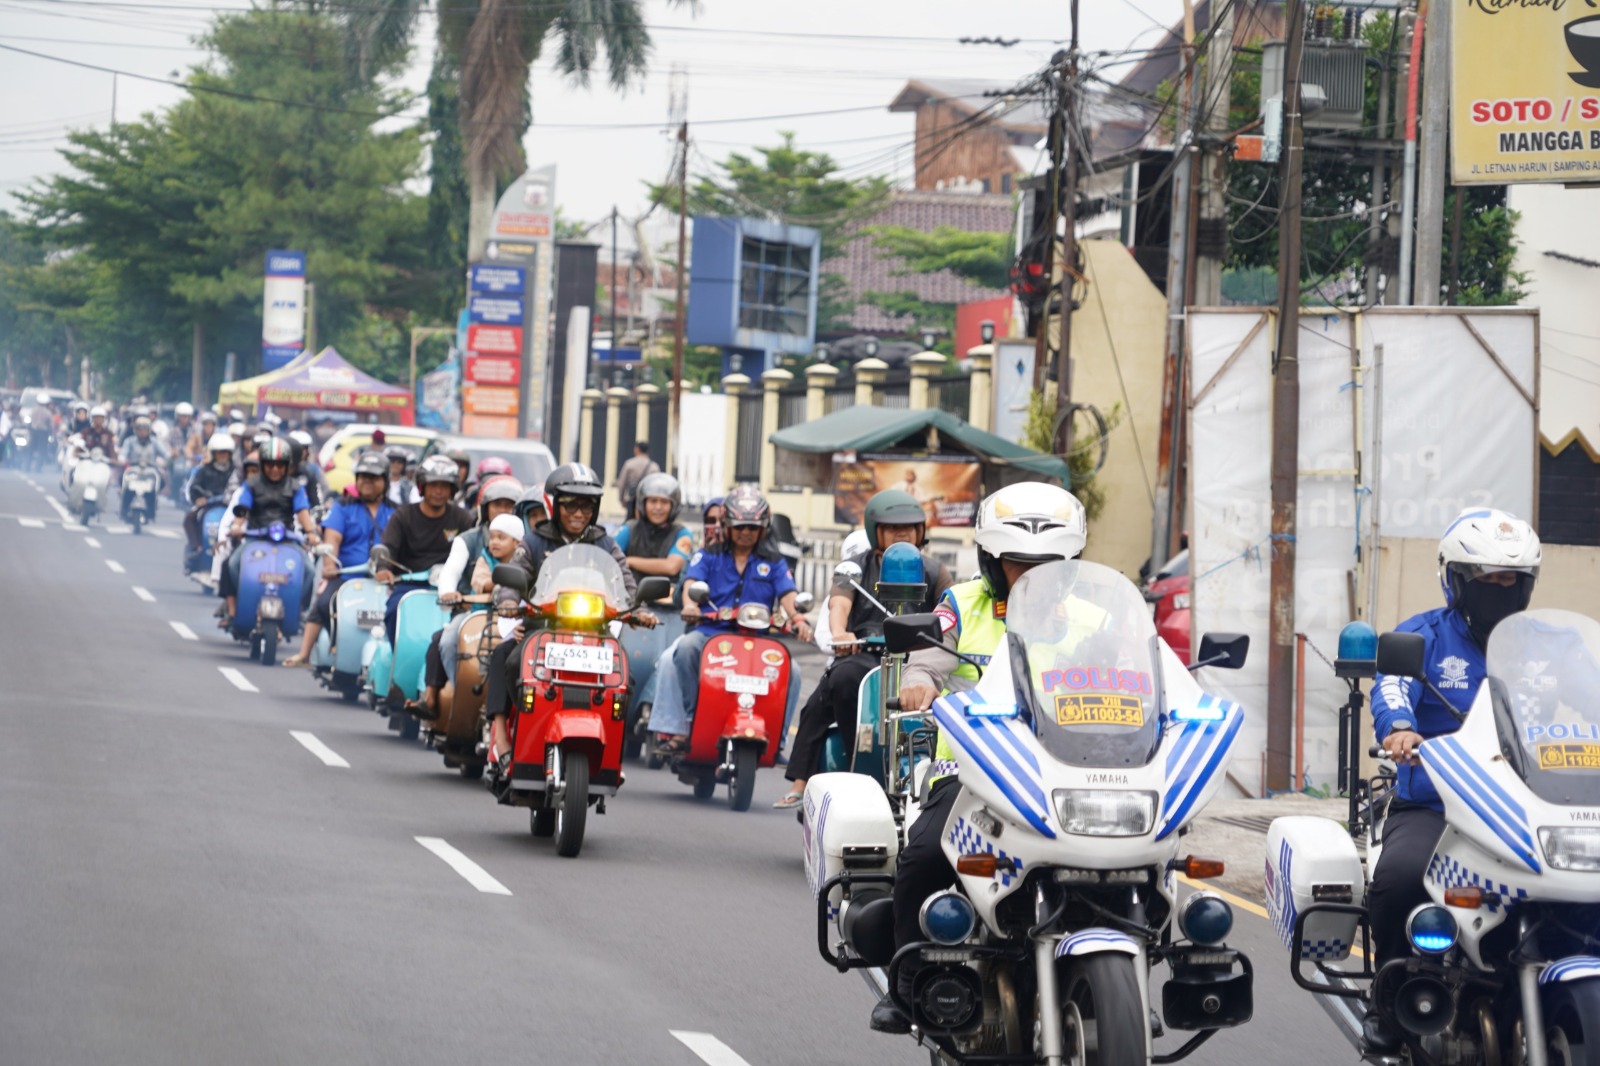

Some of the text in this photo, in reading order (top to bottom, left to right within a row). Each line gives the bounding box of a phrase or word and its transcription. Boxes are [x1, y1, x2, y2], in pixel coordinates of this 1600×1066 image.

[1472, 99, 1552, 123] SOTO
[1500, 130, 1584, 152] MANGGA
[1485, 163, 1517, 174] LETNAN
[1519, 162, 1547, 173] HARUN
[1554, 160, 1591, 172] SAMPING
[563, 648, 588, 659] 4545
[1041, 667, 1152, 695] POLISI
[1101, 697, 1121, 706] VIII
[1084, 706, 1141, 723] 11003-54
[1086, 774, 1129, 784] YAMAHA
